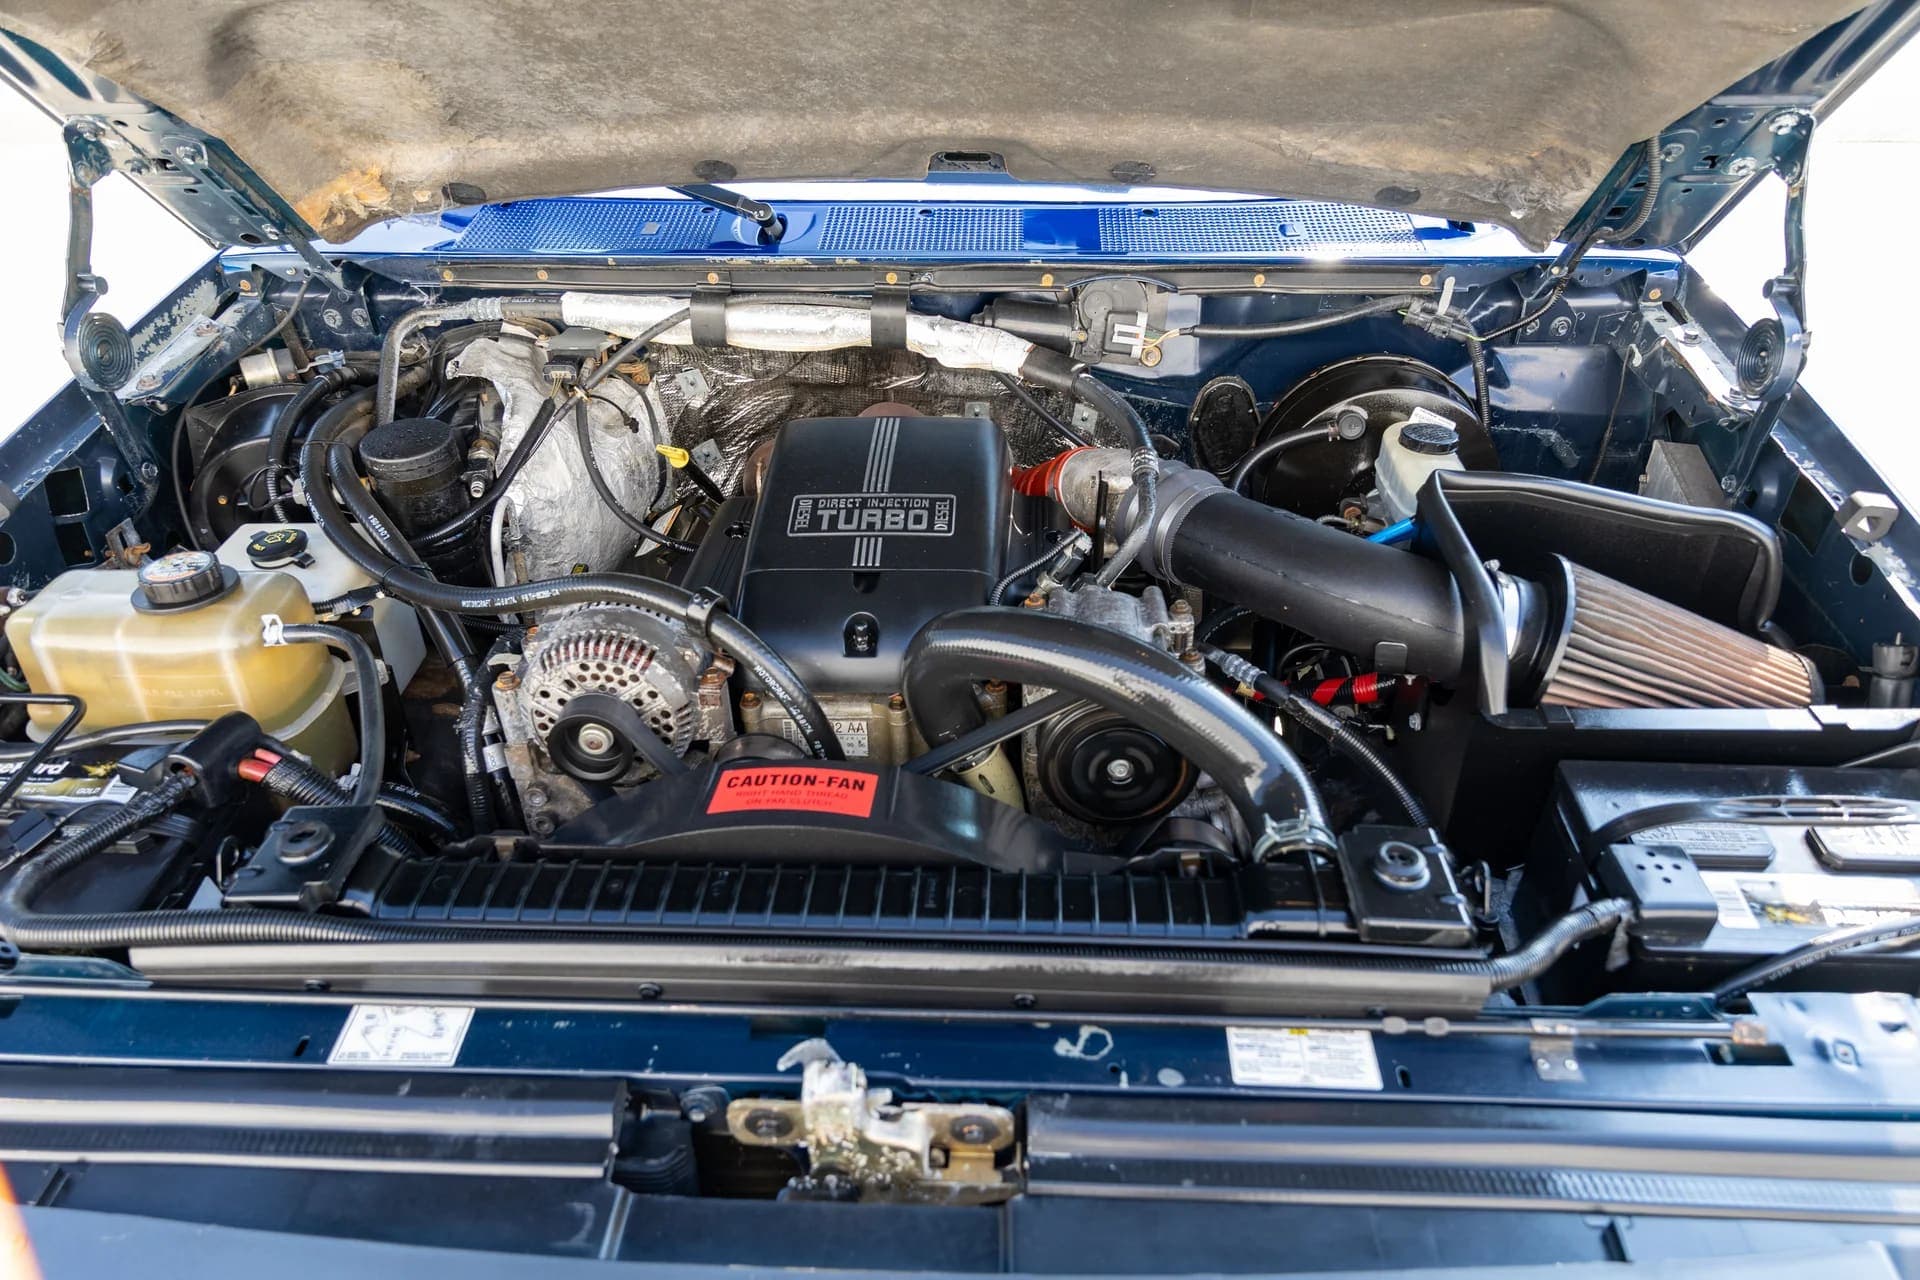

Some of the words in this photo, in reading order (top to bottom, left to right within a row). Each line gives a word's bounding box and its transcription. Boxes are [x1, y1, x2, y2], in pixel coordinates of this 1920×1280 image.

[818, 498, 862, 508] DIRECT
[867, 498, 930, 508] INJECTION
[794, 499, 813, 532] DIESEL
[816, 509, 929, 531] TURBO
[933, 499, 950, 531] DIESEL
[847, 722, 865, 733] AA
[726, 774, 866, 792] CAUTION-FAN
